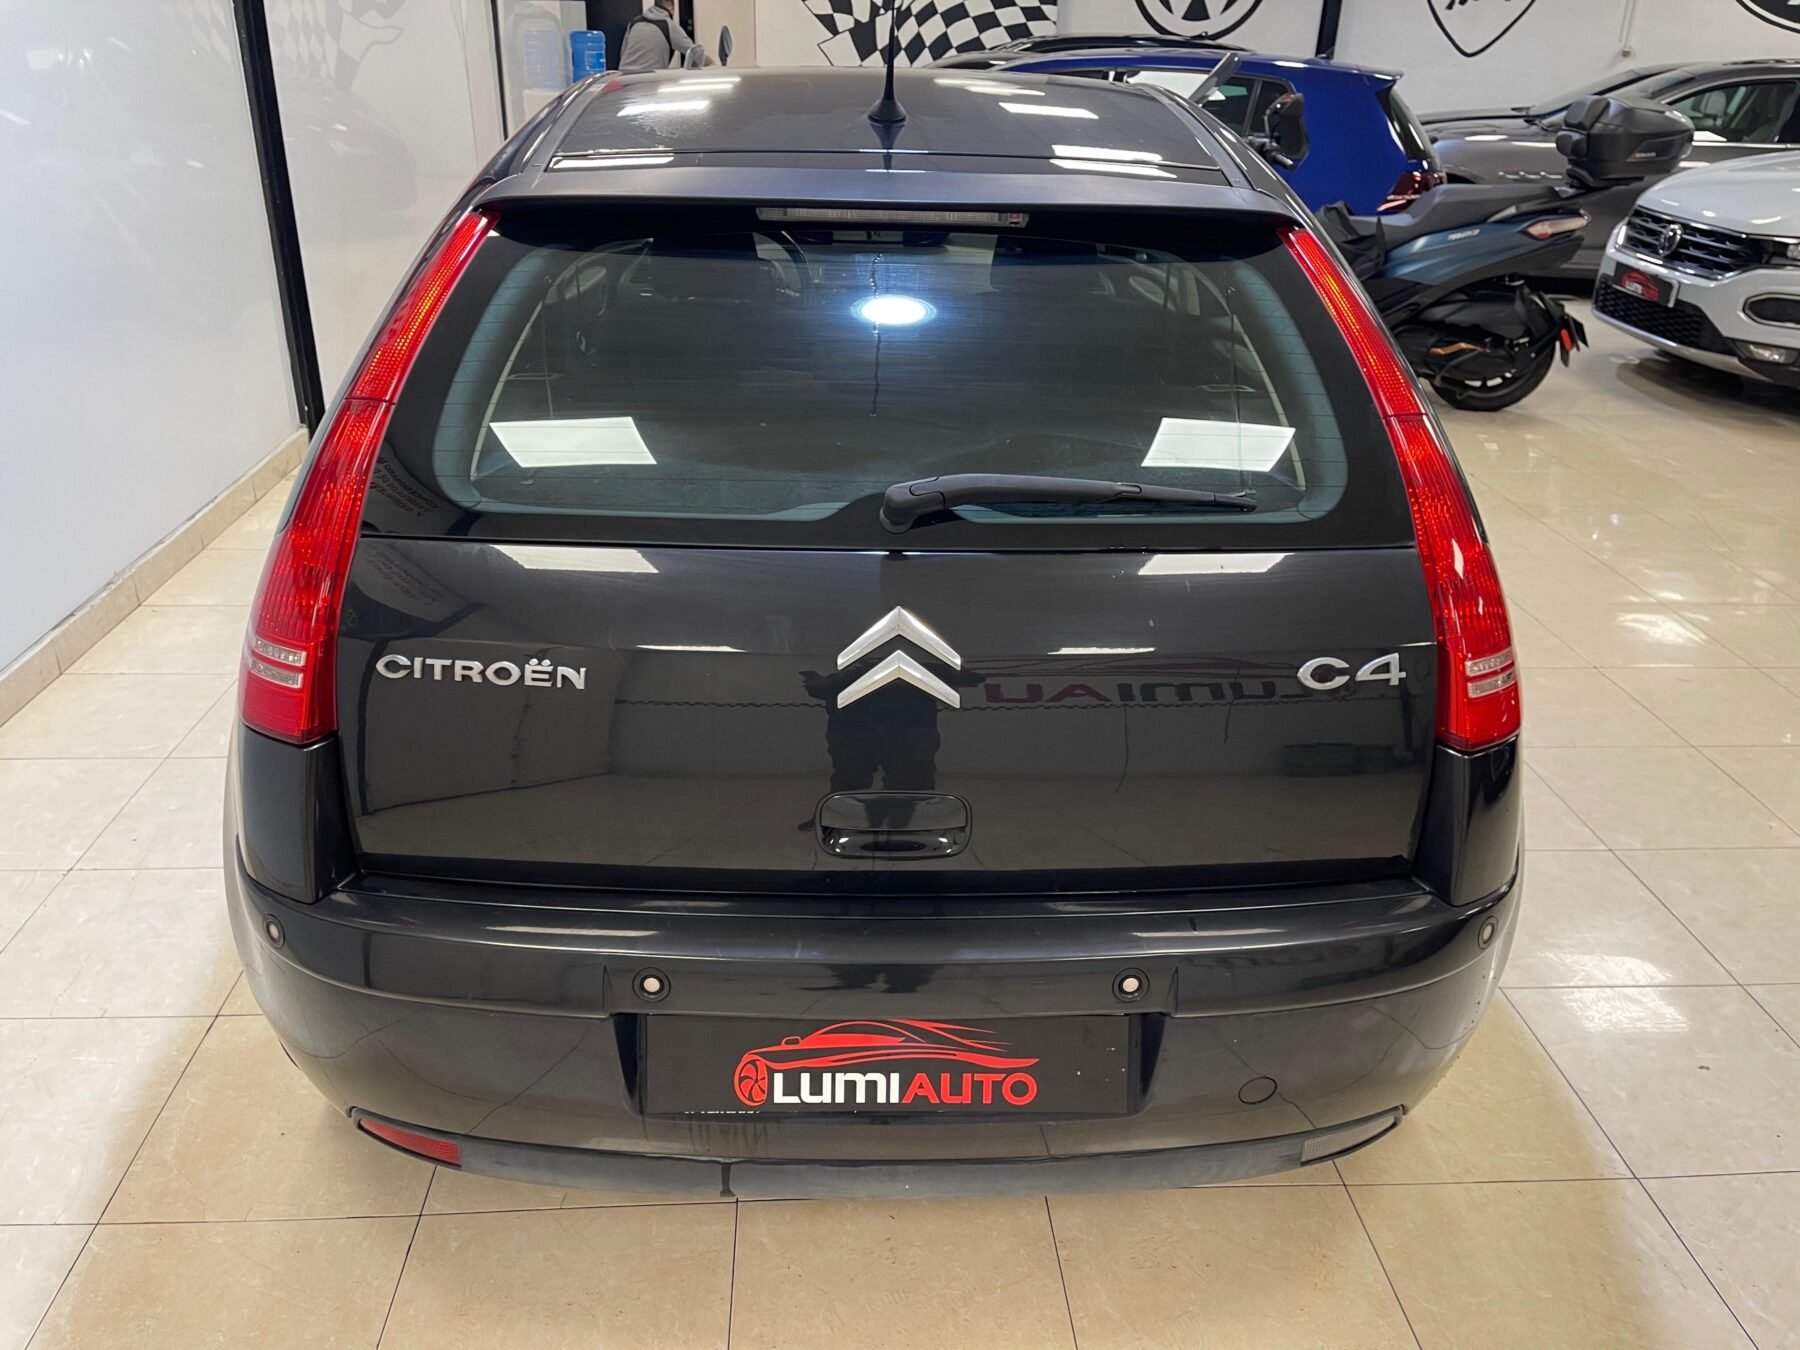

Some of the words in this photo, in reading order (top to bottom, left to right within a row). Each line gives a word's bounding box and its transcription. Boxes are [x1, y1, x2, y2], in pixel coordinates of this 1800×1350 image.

[376, 654, 587, 690] CITROËN
[1297, 652, 1406, 690] C4
[773, 1072, 1037, 1105] LUMIAUTO
